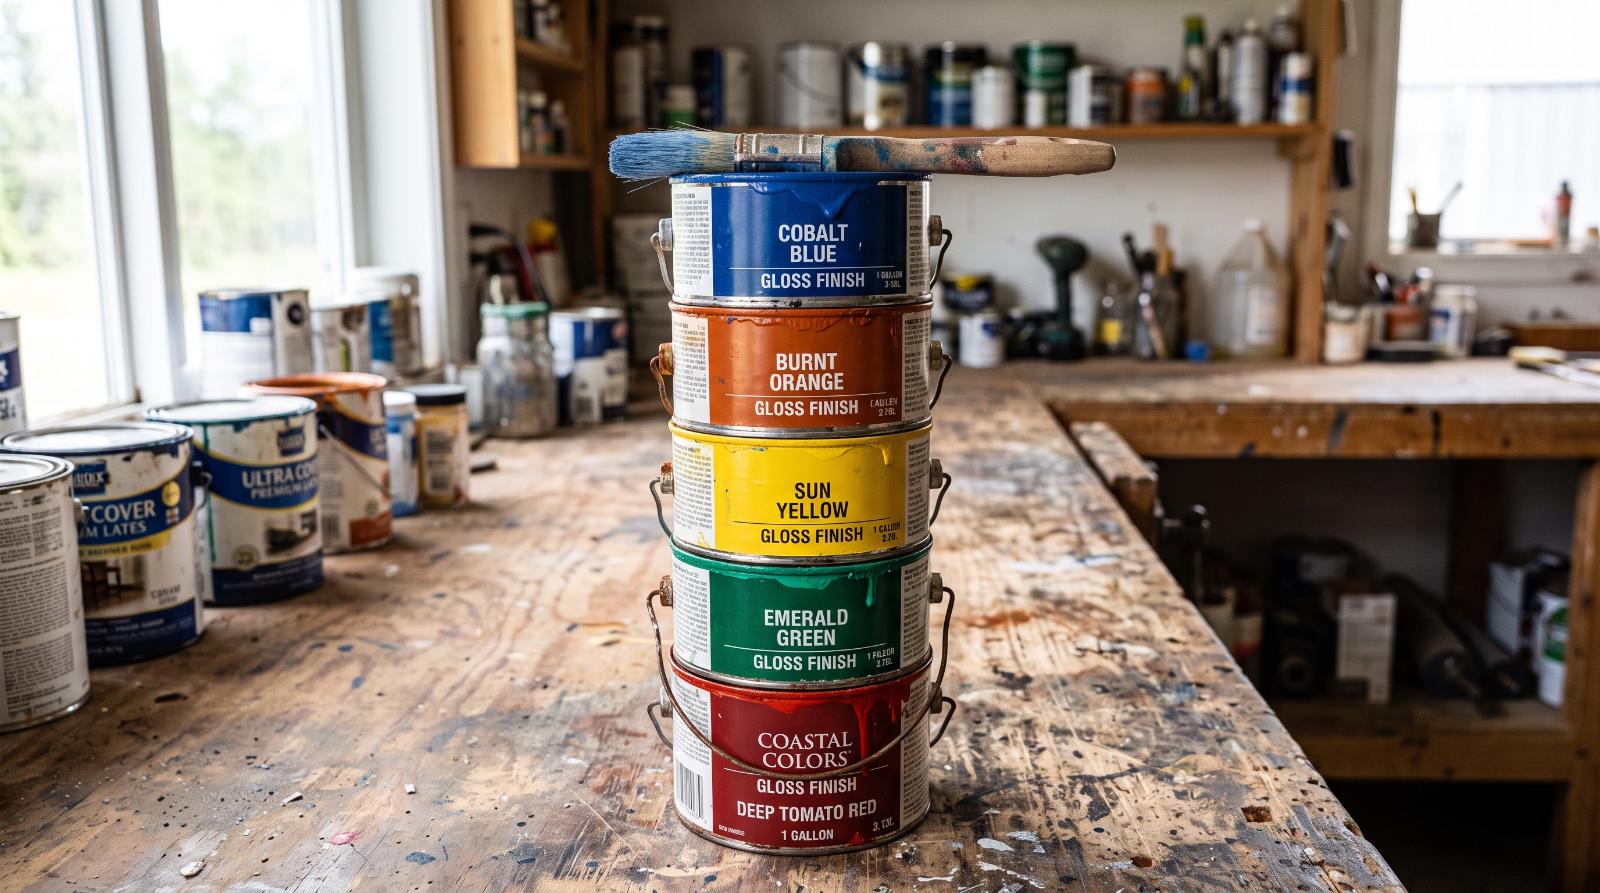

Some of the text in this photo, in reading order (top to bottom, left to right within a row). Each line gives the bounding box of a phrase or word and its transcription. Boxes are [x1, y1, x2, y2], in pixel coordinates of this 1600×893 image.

[778, 223, 848, 242] COBALT
[790, 244, 837, 263] BLUE
[760, 272, 865, 289] GLOSS FINISH
[776, 353, 838, 371] BURNT
[769, 373, 844, 391] ORANGE
[755, 400, 859, 416] GLOSS FINISH
[241, 467, 295, 489] ULTRA
[794, 482, 831, 499] SUN
[91, 500, 156, 524] COVER
[777, 501, 849, 519] YELLOW
[103, 520, 147, 538] LATES
[761, 527, 863, 544] GLOSS FINISH
[764, 609, 849, 627] EMERALD
[776, 629, 836, 646] GREEN
[753, 654, 857, 671] GLOSS FINISH
[757, 731, 853, 750] COASTAL
[756, 777, 857, 795] GLOSS FINISH
[737, 799, 877, 822] DEEP TOMATO RED
[781, 829, 834, 841] 1 GALLON
